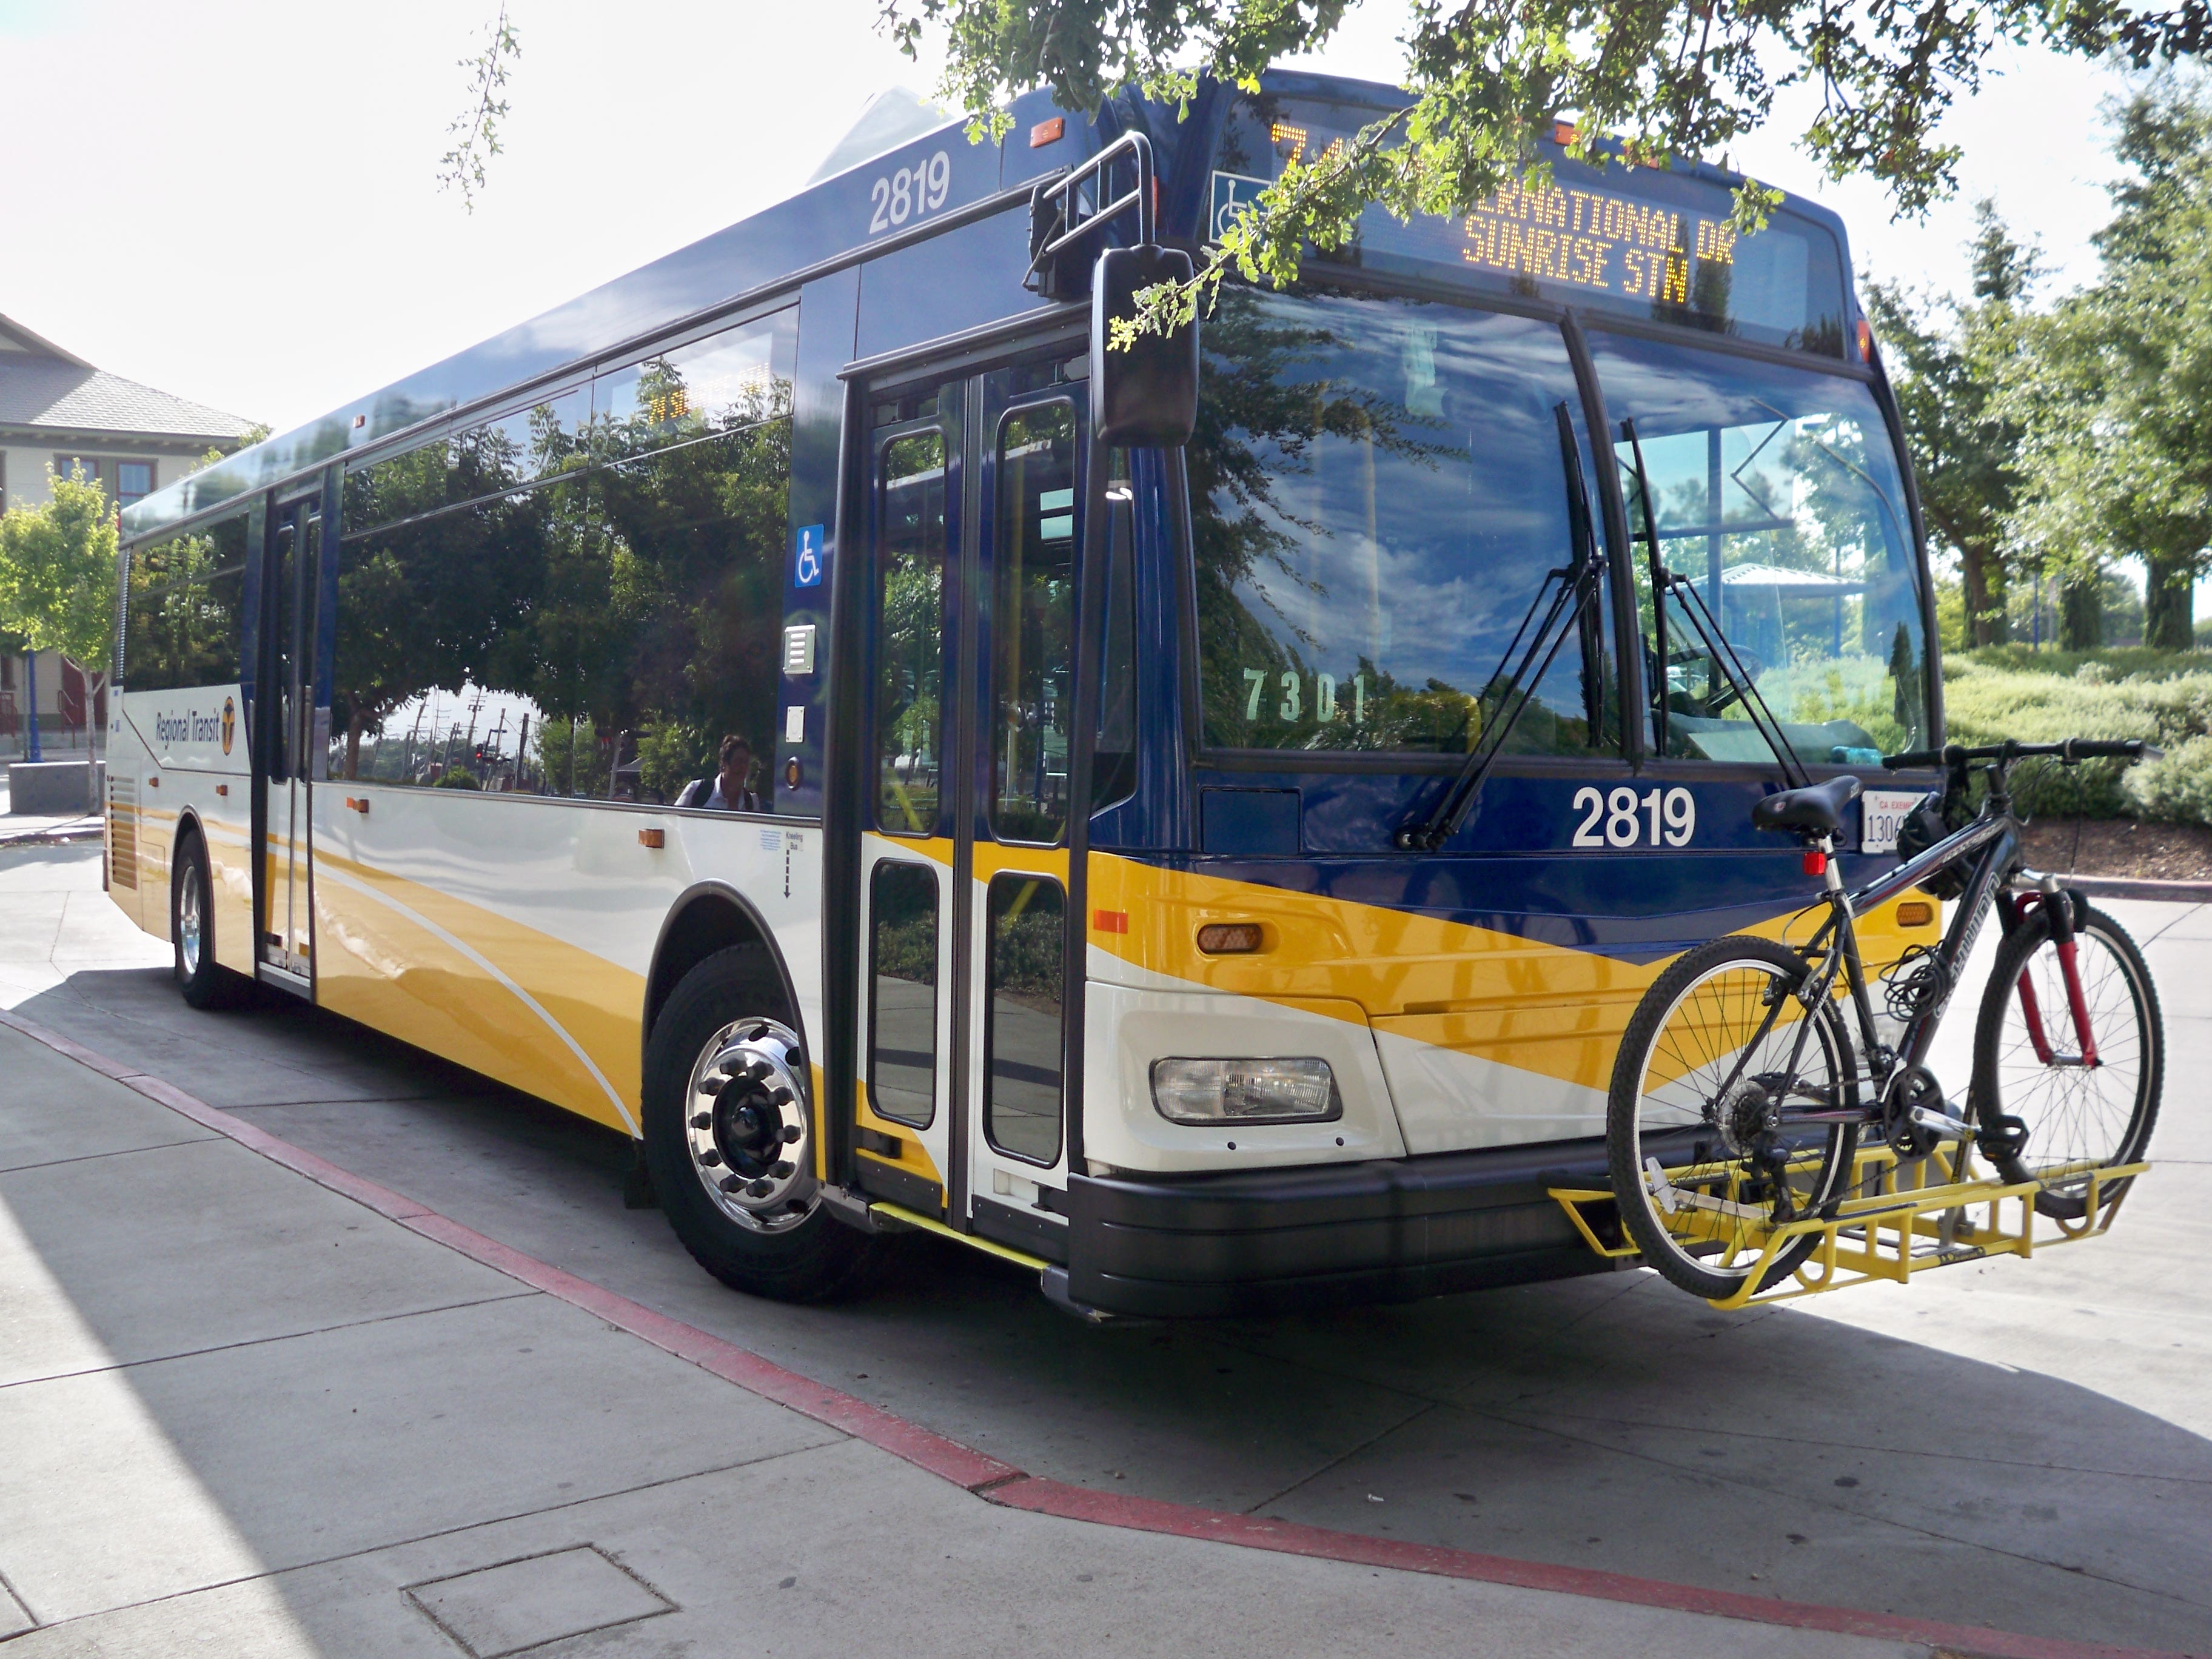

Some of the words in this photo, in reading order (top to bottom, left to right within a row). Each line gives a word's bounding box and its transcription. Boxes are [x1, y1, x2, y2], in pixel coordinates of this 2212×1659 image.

[868, 150, 950, 235] 2819
[1463, 214, 1612, 287] SUNRISE
[1623, 248, 1688, 303] STN
[1697, 219, 1737, 265] DR
[1243, 667, 1365, 723] 7301
[156, 708, 190, 750] Regional
[192, 707, 220, 742] Transit
[786, 831, 803, 842] Kneeling
[1572, 786, 1695, 847] 2819
